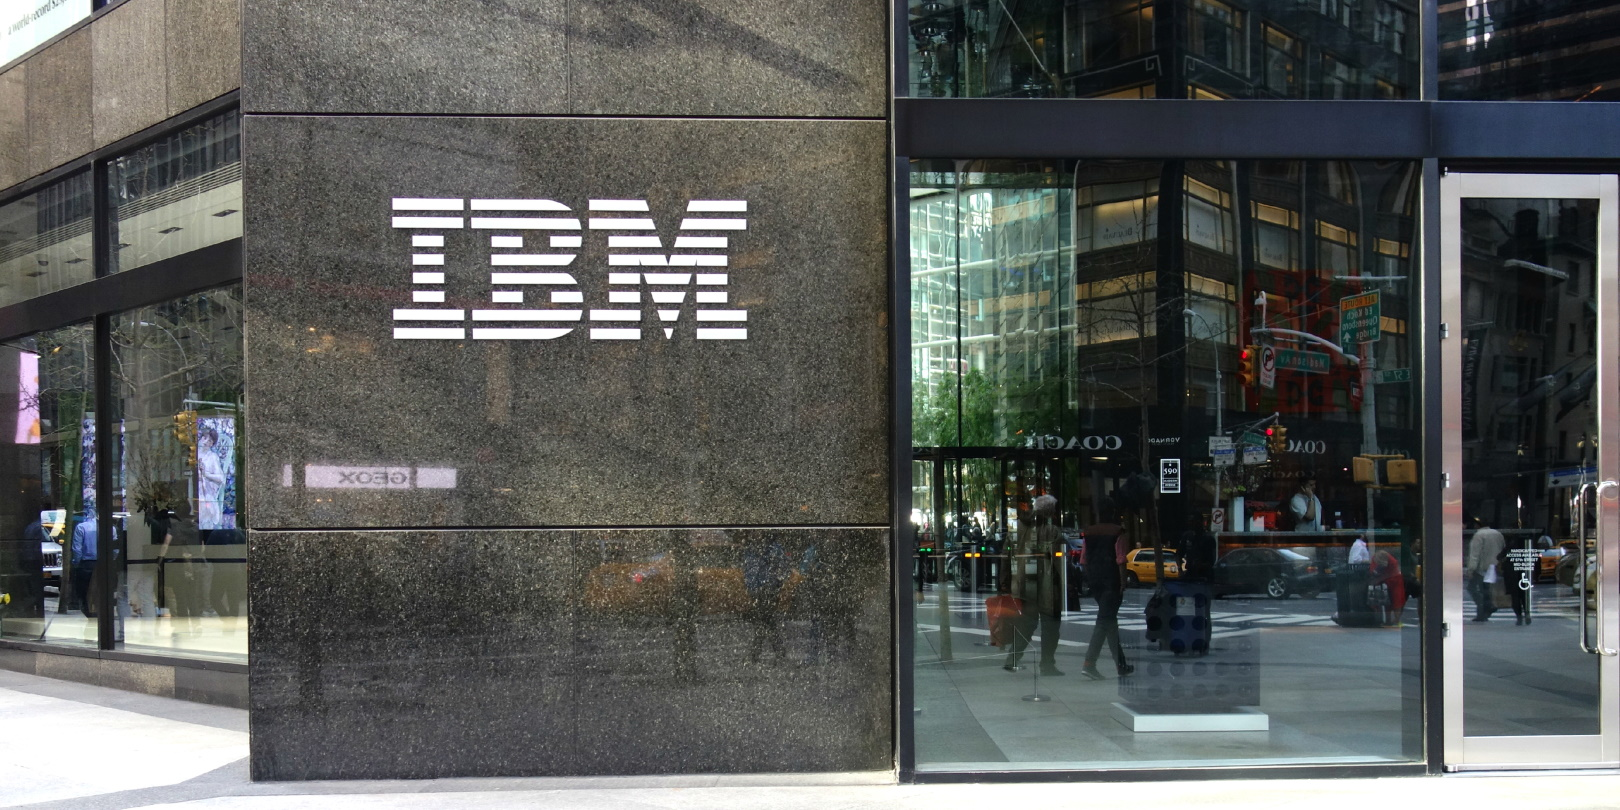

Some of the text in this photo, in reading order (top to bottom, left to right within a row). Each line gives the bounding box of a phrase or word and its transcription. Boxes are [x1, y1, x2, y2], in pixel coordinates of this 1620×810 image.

[12, 0, 51, 32] world-record
[392, 198, 748, 340] IBM
[1163, 467, 1178, 475] 590
